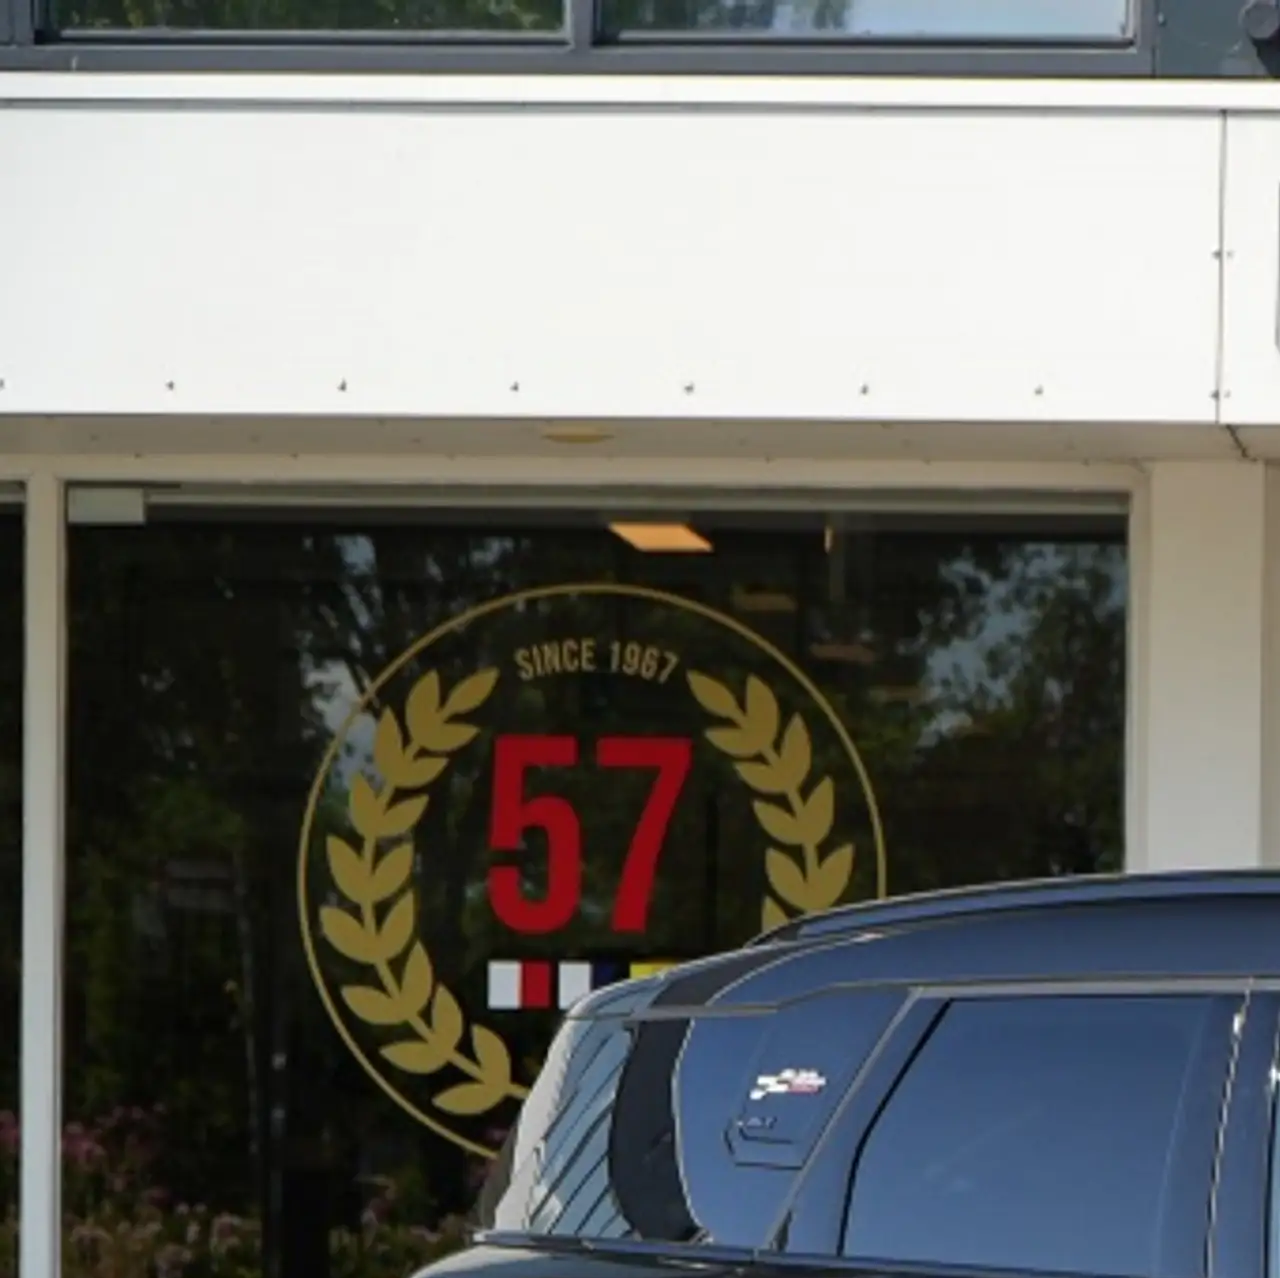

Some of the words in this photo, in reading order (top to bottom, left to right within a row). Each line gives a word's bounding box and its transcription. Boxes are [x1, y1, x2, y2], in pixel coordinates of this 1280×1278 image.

[513, 637, 597, 681] SINCE
[609, 639, 680, 685] 1967
[488, 736, 692, 933] 57
